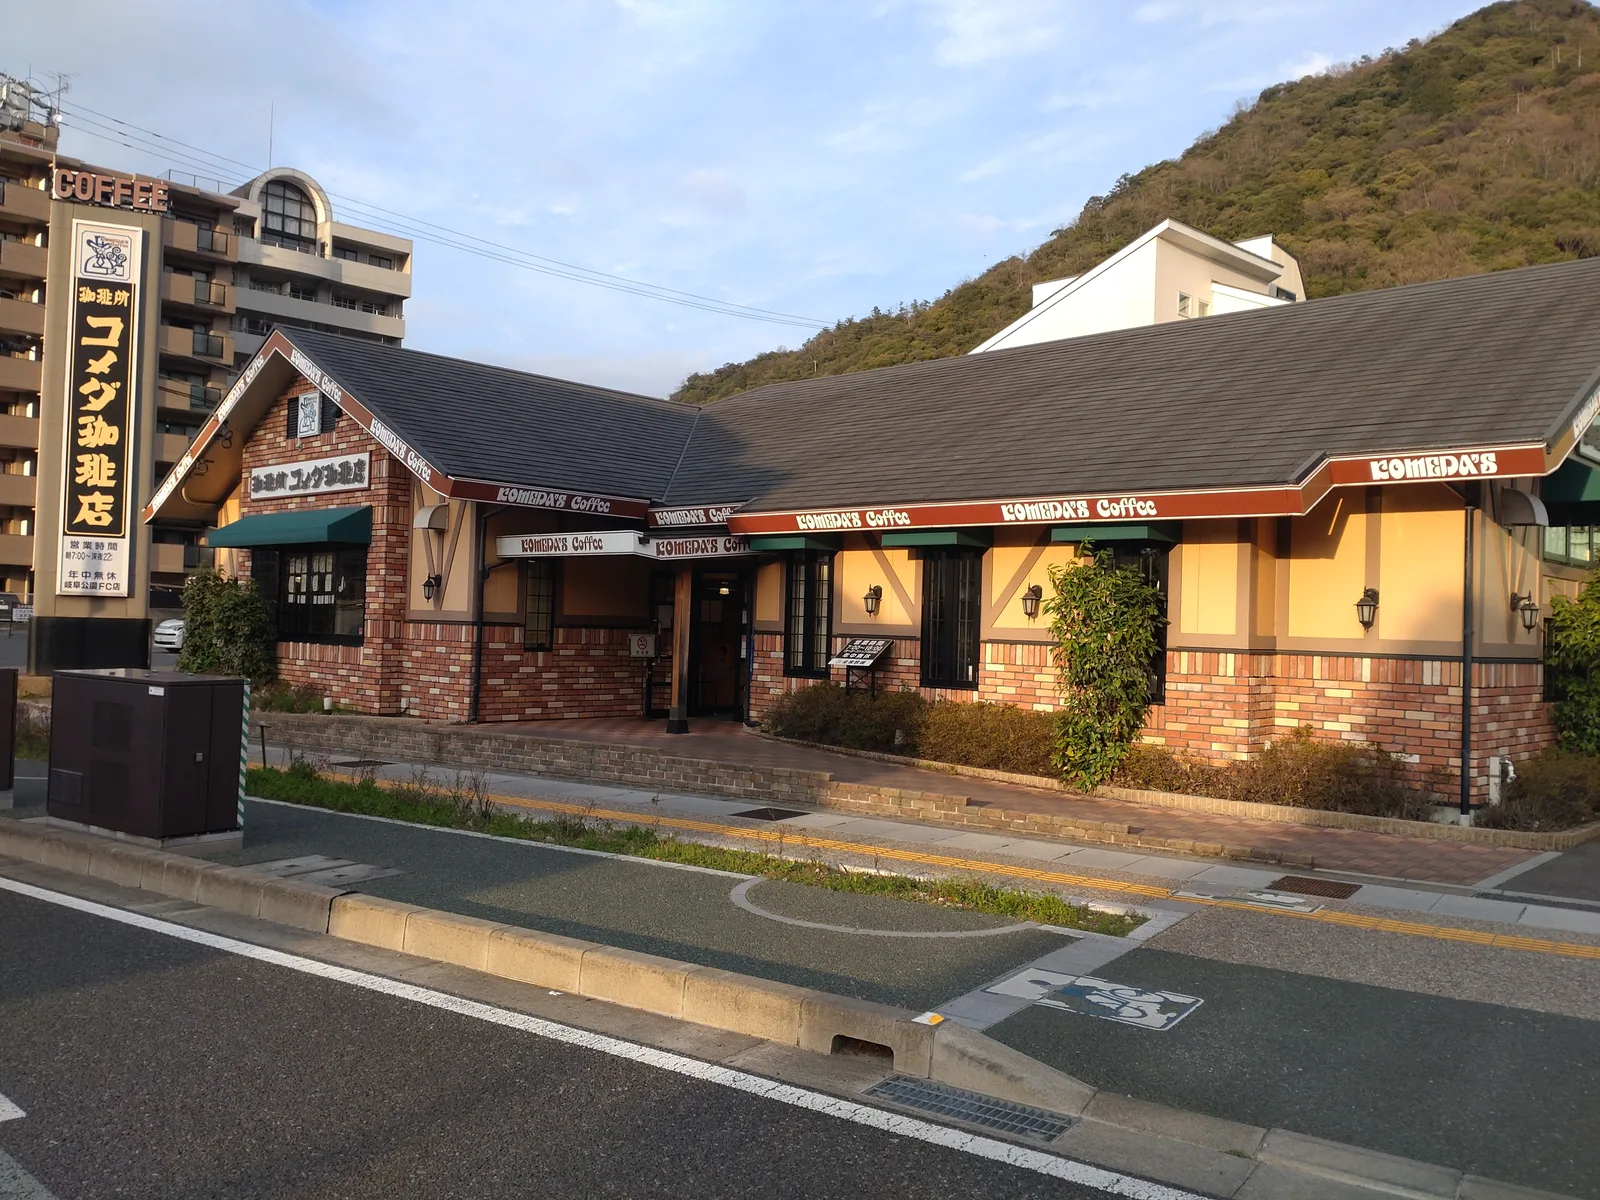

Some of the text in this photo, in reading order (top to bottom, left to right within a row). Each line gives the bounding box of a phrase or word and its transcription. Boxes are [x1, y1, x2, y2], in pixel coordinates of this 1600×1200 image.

[54, 168, 169, 212] COFFEE
[78, 286, 130, 307] 珈琲所
[321, 375, 342, 402] Coffee
[72, 315, 125, 527] コメダ珈琲店
[370, 417, 432, 481] KOMEDA'S Coffee
[1369, 452, 1498, 481] KOMEDA'S
[496, 486, 611, 513] KOMEDA'S Coffee
[1000, 497, 1158, 522] KOMEDA'S Coffee
[654, 507, 734, 525] KOMEDA'S Coff
[795, 509, 911, 530] KOMEDA'S Coffee
[69, 540, 118, 551] 営業時間
[520, 536, 604, 553] KOMEDA'S Coffee
[655, 538, 718, 556] KOMEDA'S
[68, 570, 117, 580] 年中無休
[64, 581, 121, 591] 岐阜公園FC店
